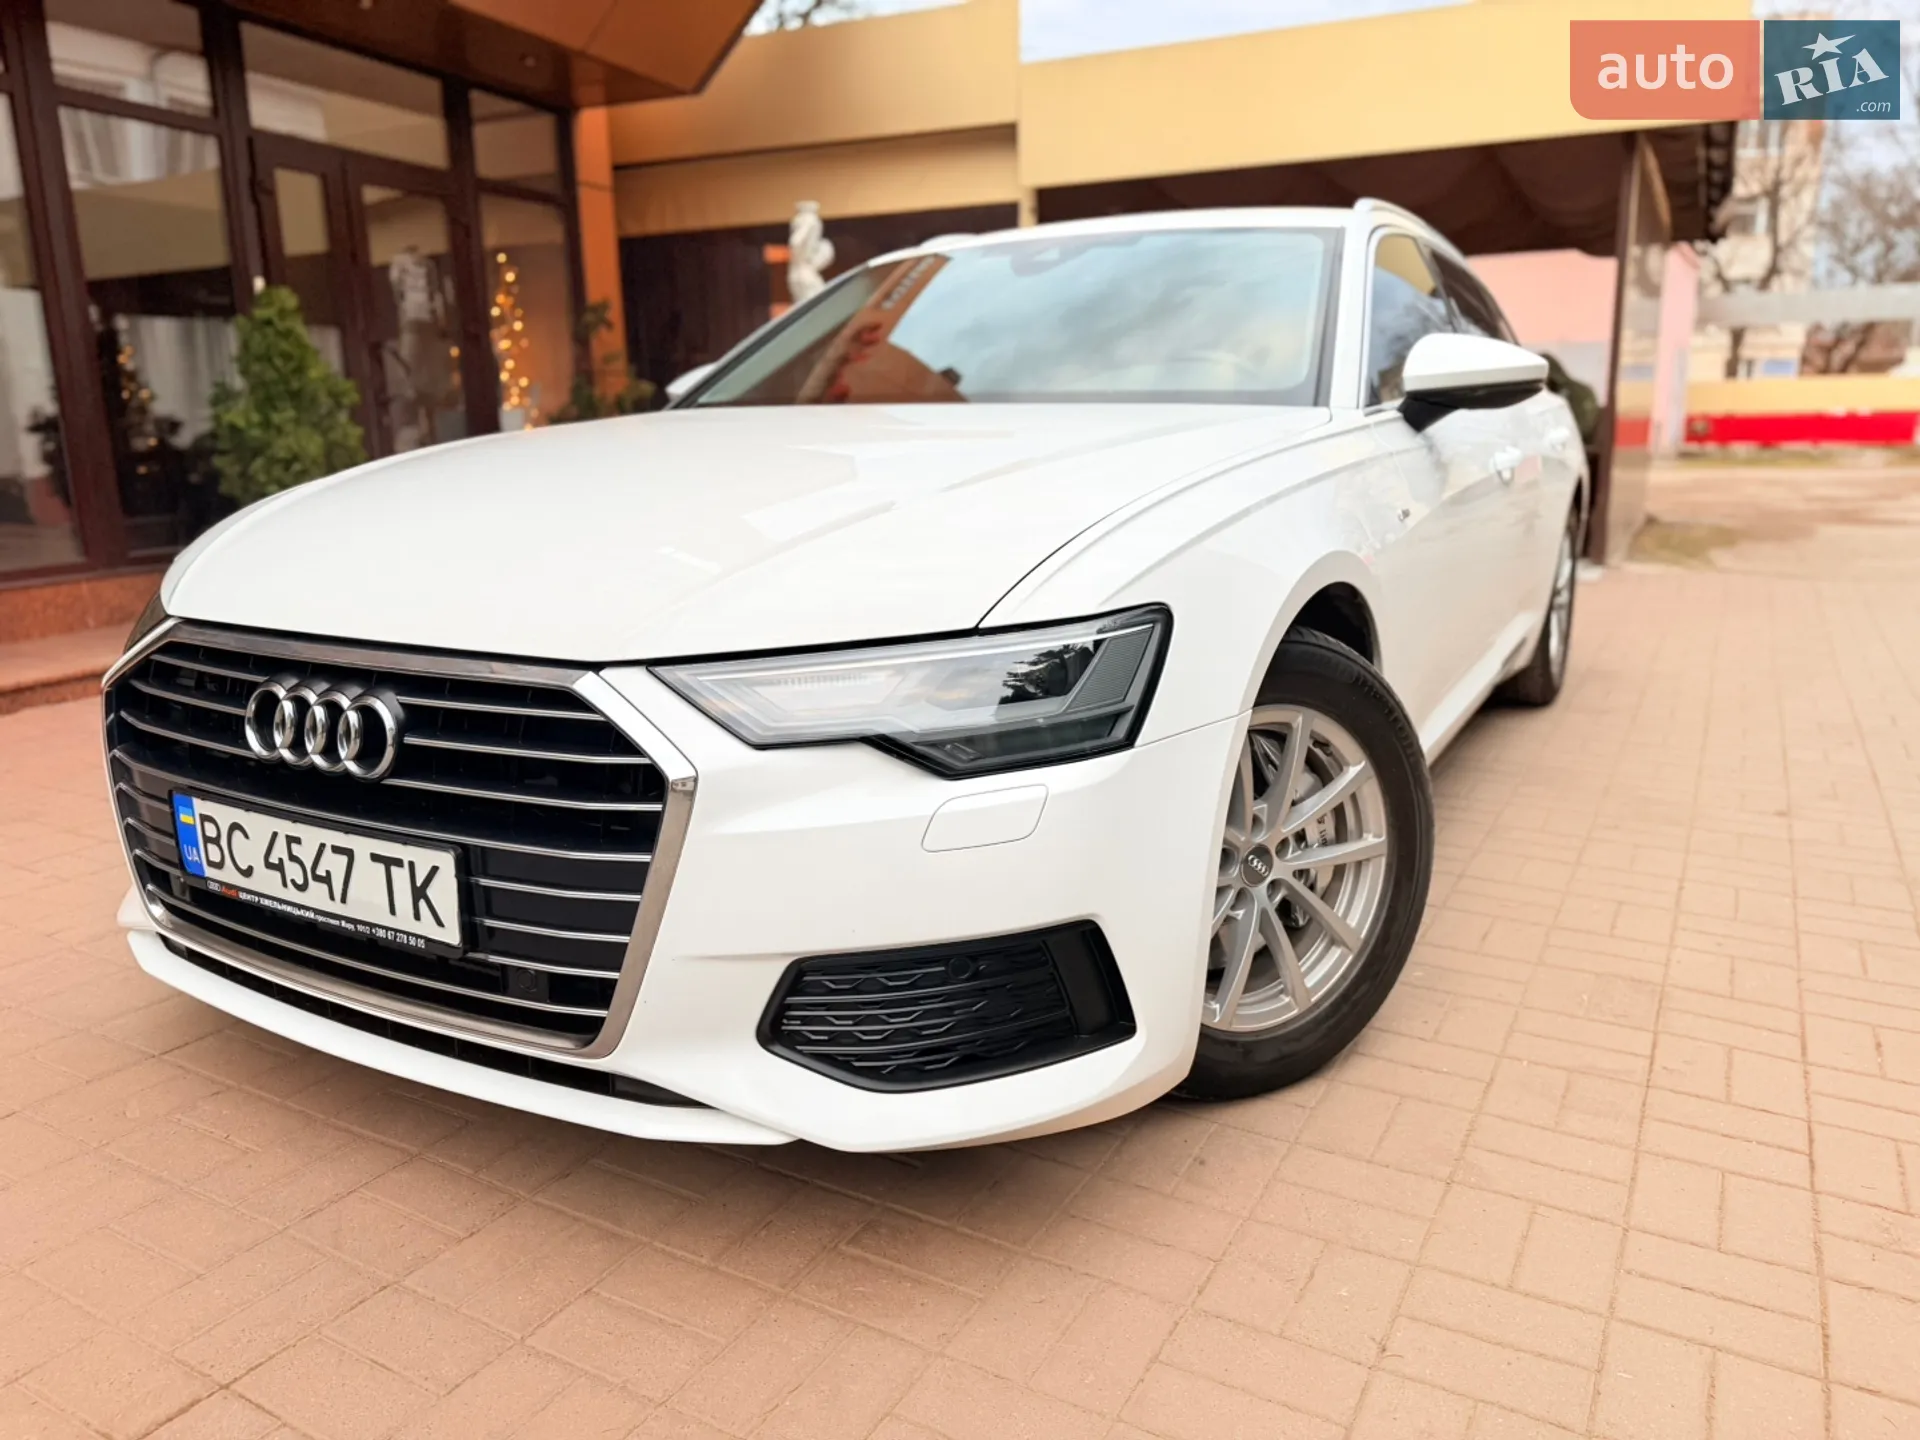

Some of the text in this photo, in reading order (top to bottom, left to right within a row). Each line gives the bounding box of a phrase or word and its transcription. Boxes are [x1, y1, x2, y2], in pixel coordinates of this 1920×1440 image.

[183, 843, 201, 864] UA
[198, 812, 446, 929] BC 4547 TK
[221, 884, 239, 898] Audi
